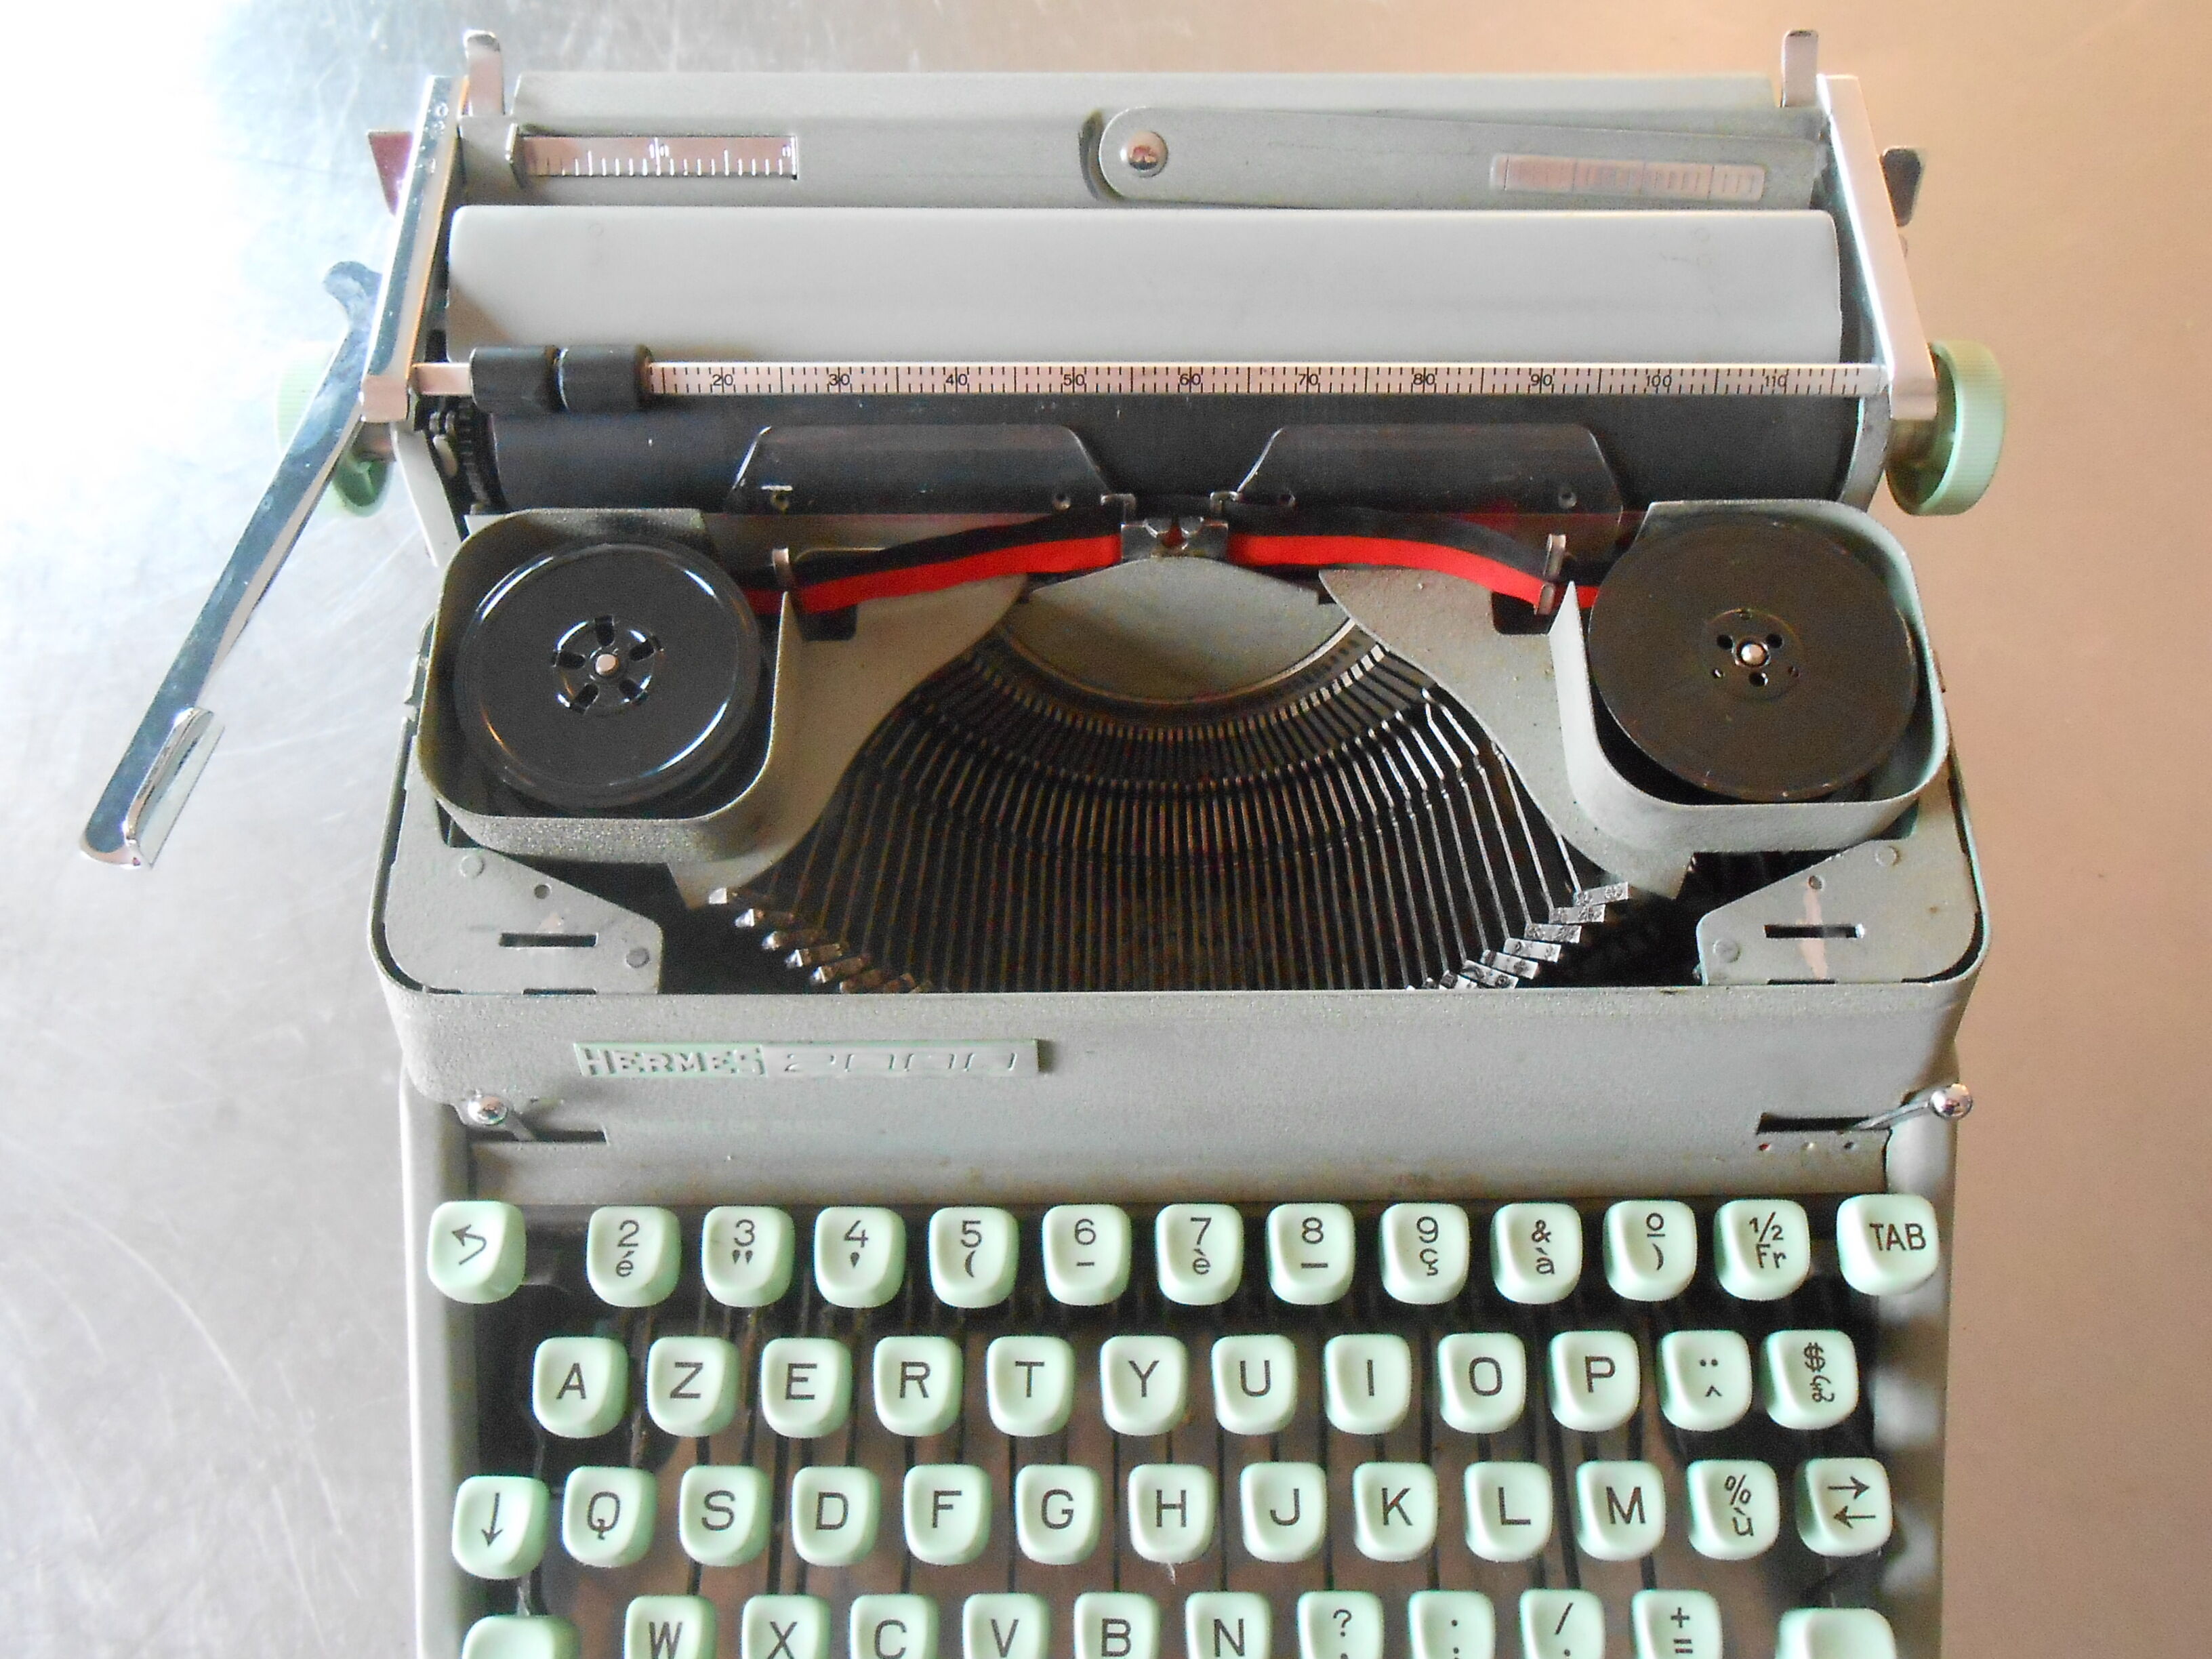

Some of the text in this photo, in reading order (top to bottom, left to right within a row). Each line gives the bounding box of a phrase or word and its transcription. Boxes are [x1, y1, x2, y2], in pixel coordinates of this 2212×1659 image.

[712, 373, 1788, 388] 20 30 40 50 60 70 80 90 100 110
[577, 1046, 766, 1076] HERMES
[617, 1219, 640, 1248] 2
[733, 1218, 756, 1248] 3
[844, 1220, 869, 1248] 4
[960, 1220, 983, 1249] 5
[1074, 1218, 1097, 1246] 6
[1190, 1216, 1212, 1246] 7
[1301, 1216, 1324, 1245] 8
[1416, 1216, 1439, 1244] 9
[1531, 1219, 1552, 1244] &
[1868, 1223, 1927, 1252] TAB
[1755, 1243, 1787, 1269] Fr
[1468, 1356, 1503, 1397] O
[1584, 1355, 1616, 1393] P
[1803, 1342, 1826, 1373] $
[556, 1362, 587, 1400] A
[670, 1361, 703, 1399] Z
[785, 1363, 818, 1401] E
[899, 1361, 931, 1399] R
[1015, 1360, 1045, 1398] T
[1128, 1359, 1160, 1398] Y
[1240, 1359, 1271, 1397] U
[1366, 1359, 1375, 1397] I
[1041, 1488, 1074, 1530] G
[1155, 1489, 1187, 1528] H
[1269, 1488, 1300, 1527] J
[1381, 1488, 1413, 1526] K
[1498, 1486, 1532, 1526] L
[1605, 1486, 1646, 1525] M
[1724, 1474, 1752, 1506] %
[587, 1491, 621, 1541] Q
[701, 1490, 736, 1532] S
[815, 1492, 849, 1531] D
[932, 1490, 962, 1529] F
[1332, 1609, 1353, 1637] ?
[1670, 1607, 1691, 1629] +
[648, 1621, 683, 1659] W
[766, 1621, 798, 1659] X
[874, 1619, 907, 1659] C
[990, 1618, 1019, 1658] V
[1101, 1618, 1132, 1658] B
[1213, 1618, 1246, 1658] N
[1673, 1638, 1694, 1654] =
